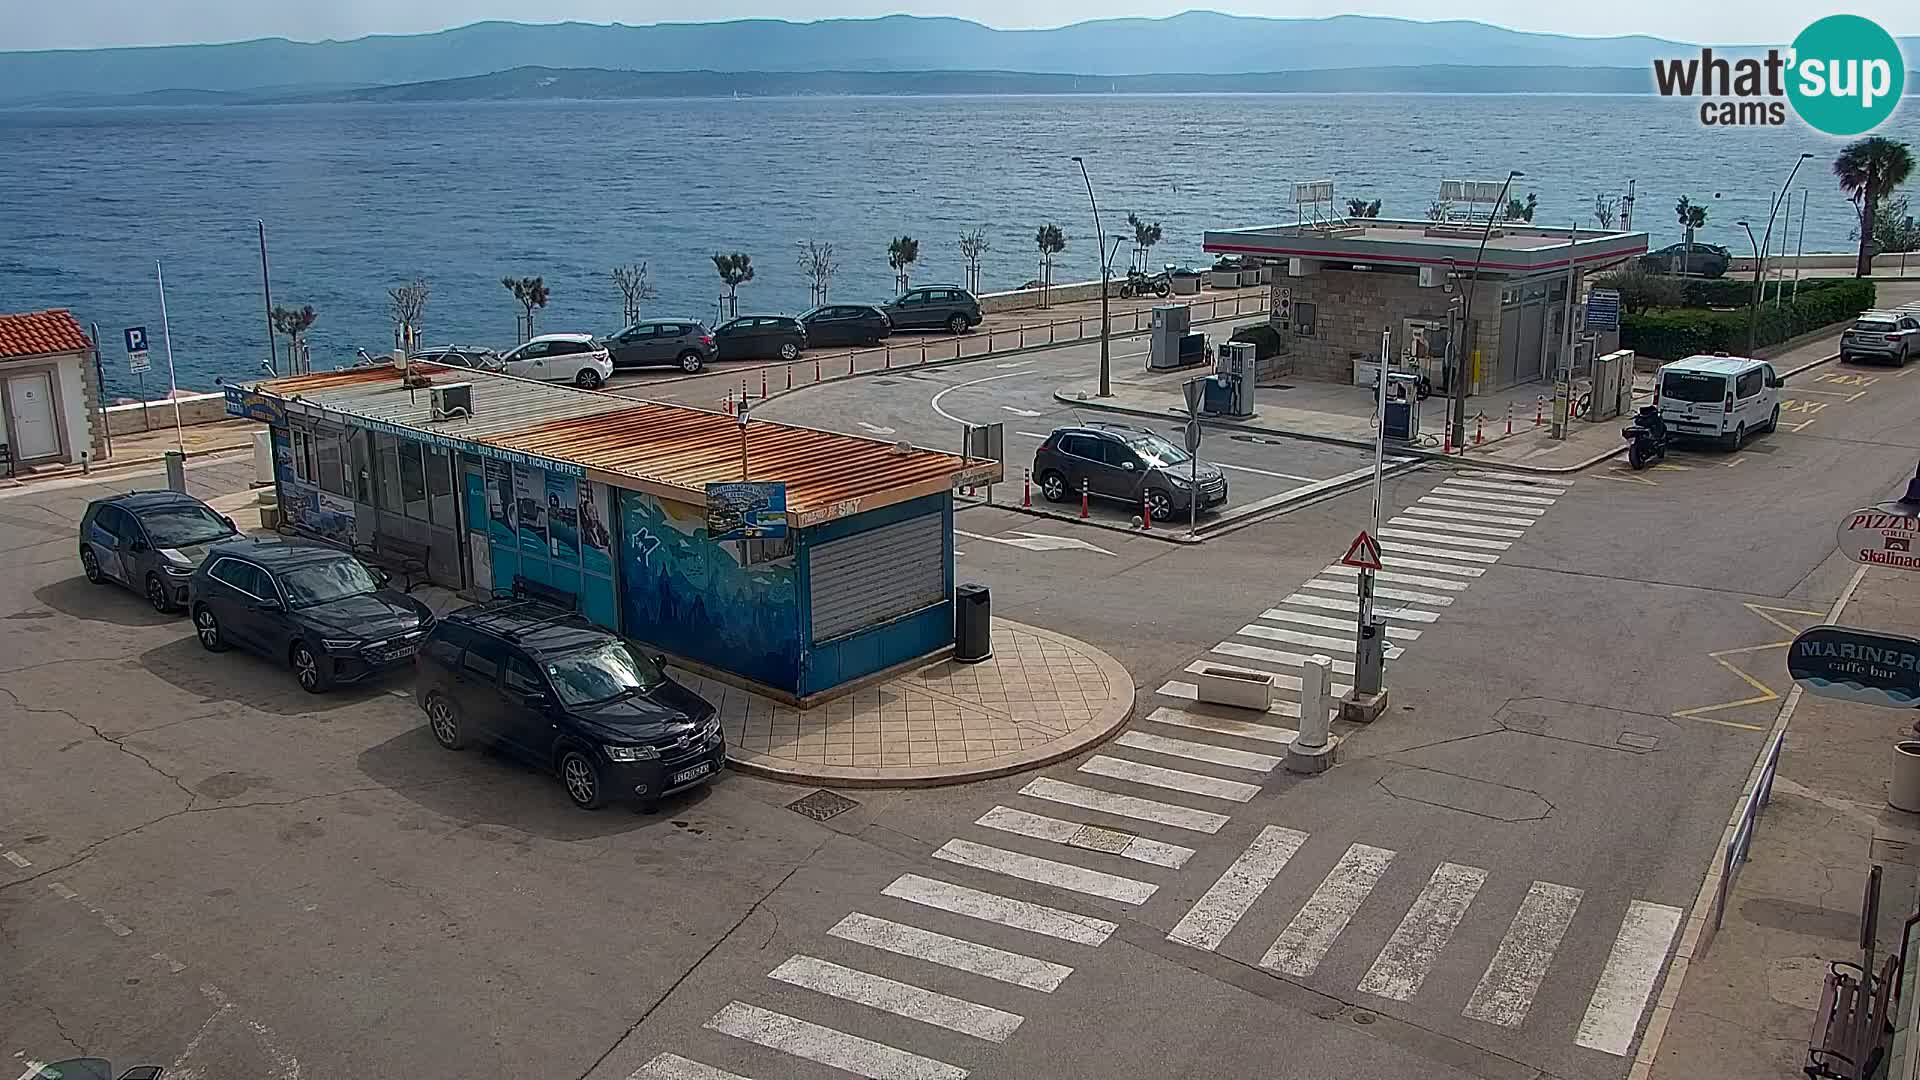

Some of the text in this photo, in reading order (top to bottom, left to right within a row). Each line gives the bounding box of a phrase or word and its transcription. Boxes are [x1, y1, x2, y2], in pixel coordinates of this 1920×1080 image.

[130, 330, 142, 349] P
[396, 425, 436, 443] AUTOBUSNA
[436, 435, 467, 450] POSTAJA
[478, 446, 492, 456] BUS
[493, 449, 526, 464] STATION
[527, 456, 554, 470] TICKET
[555, 461, 582, 477] OFFICE
[1848, 513, 1920, 532] PIZZE
[1881, 529, 1917, 540] GRILL
[1828, 660, 1897, 679] caffe bar
